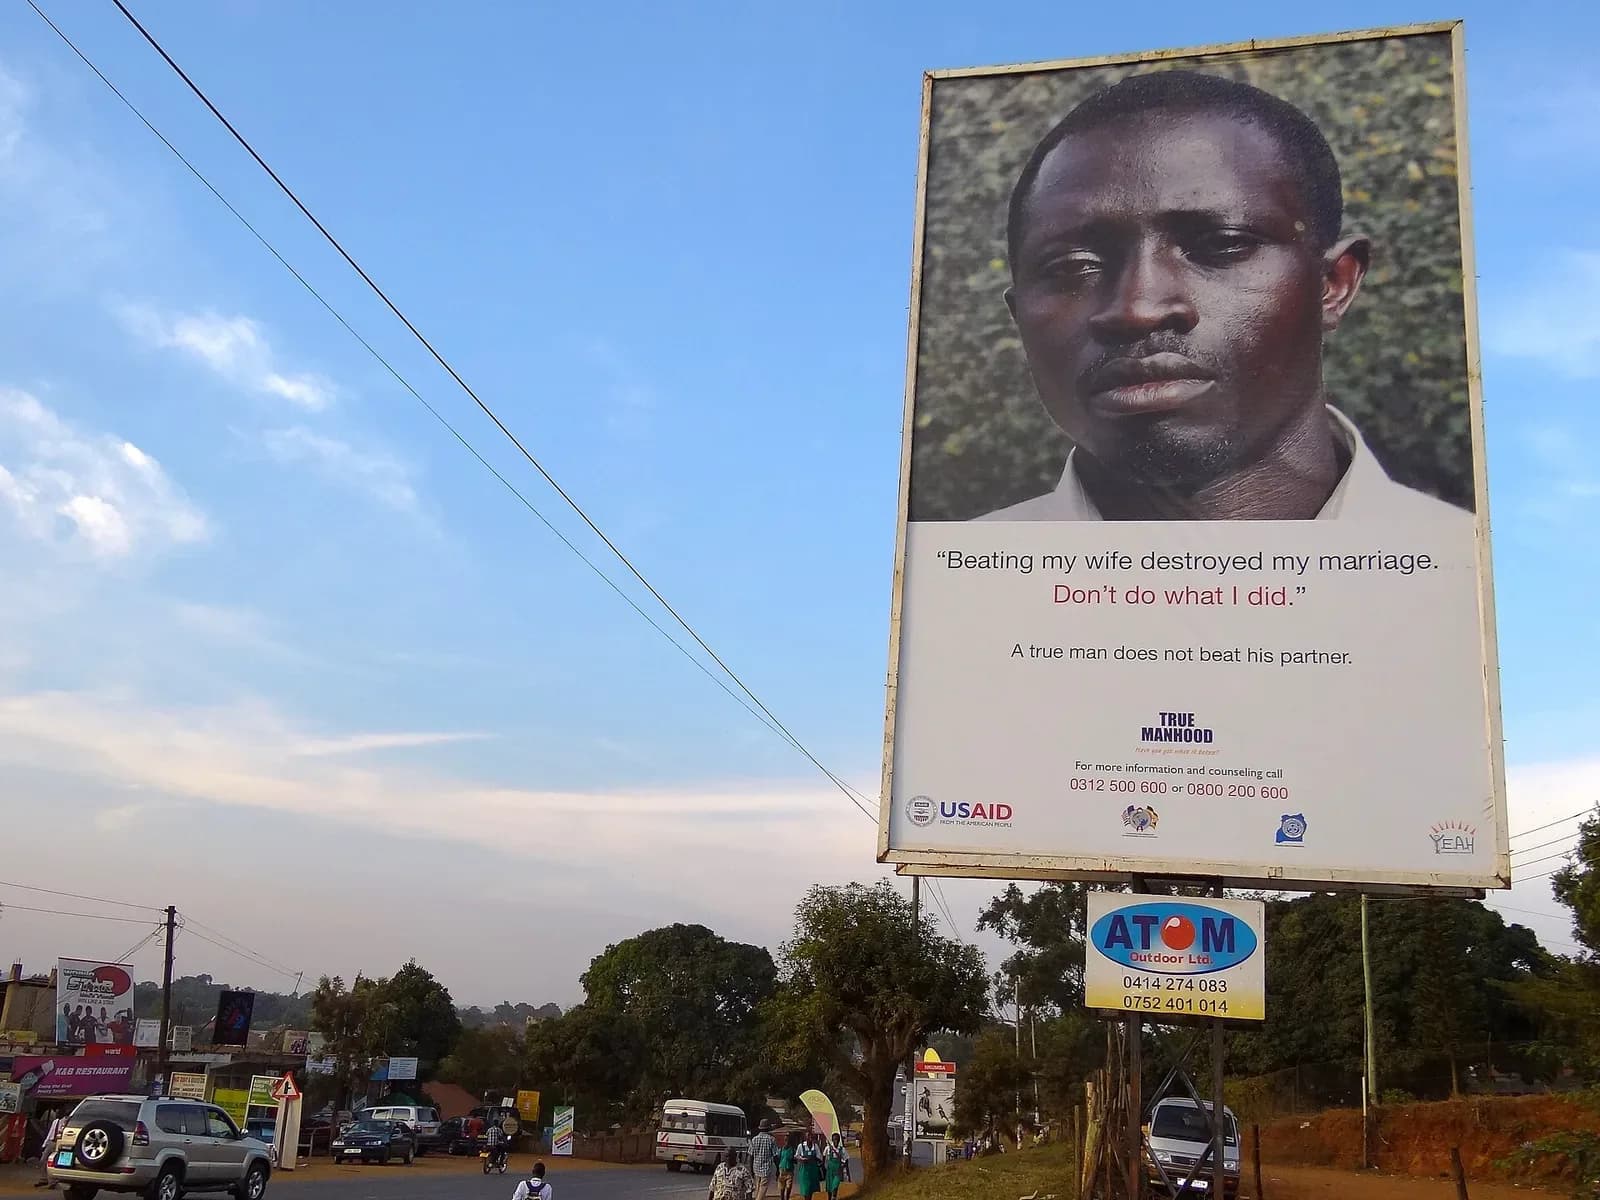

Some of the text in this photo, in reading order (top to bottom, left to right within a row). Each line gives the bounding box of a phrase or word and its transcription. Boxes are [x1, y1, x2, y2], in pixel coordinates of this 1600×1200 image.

[936, 549, 1439, 576] “Beating my wife destroyed my marriage.
[1054, 584, 1306, 606] Don’t do what I did.”
[1010, 643, 1353, 668] A true man does not beat his partner.
[1158, 712, 1195, 727] TRUE
[1141, 727, 1213, 743] MANHOOD
[1075, 760, 1283, 781] For more information and counseling call
[1070, 777, 1289, 800] 0312 500 600 or 0800 200 600
[940, 801, 1013, 820] USAID
[1428, 833, 1475, 855] YEAH
[1104, 914, 1235, 953] ATOM
[1129, 951, 1213, 965] Outdoor Ltd.
[1123, 976, 1227, 993] 0414 274 083
[1123, 995, 1228, 1012] 0752 401 014
[76, 1066, 129, 1076] RESTAURANT
